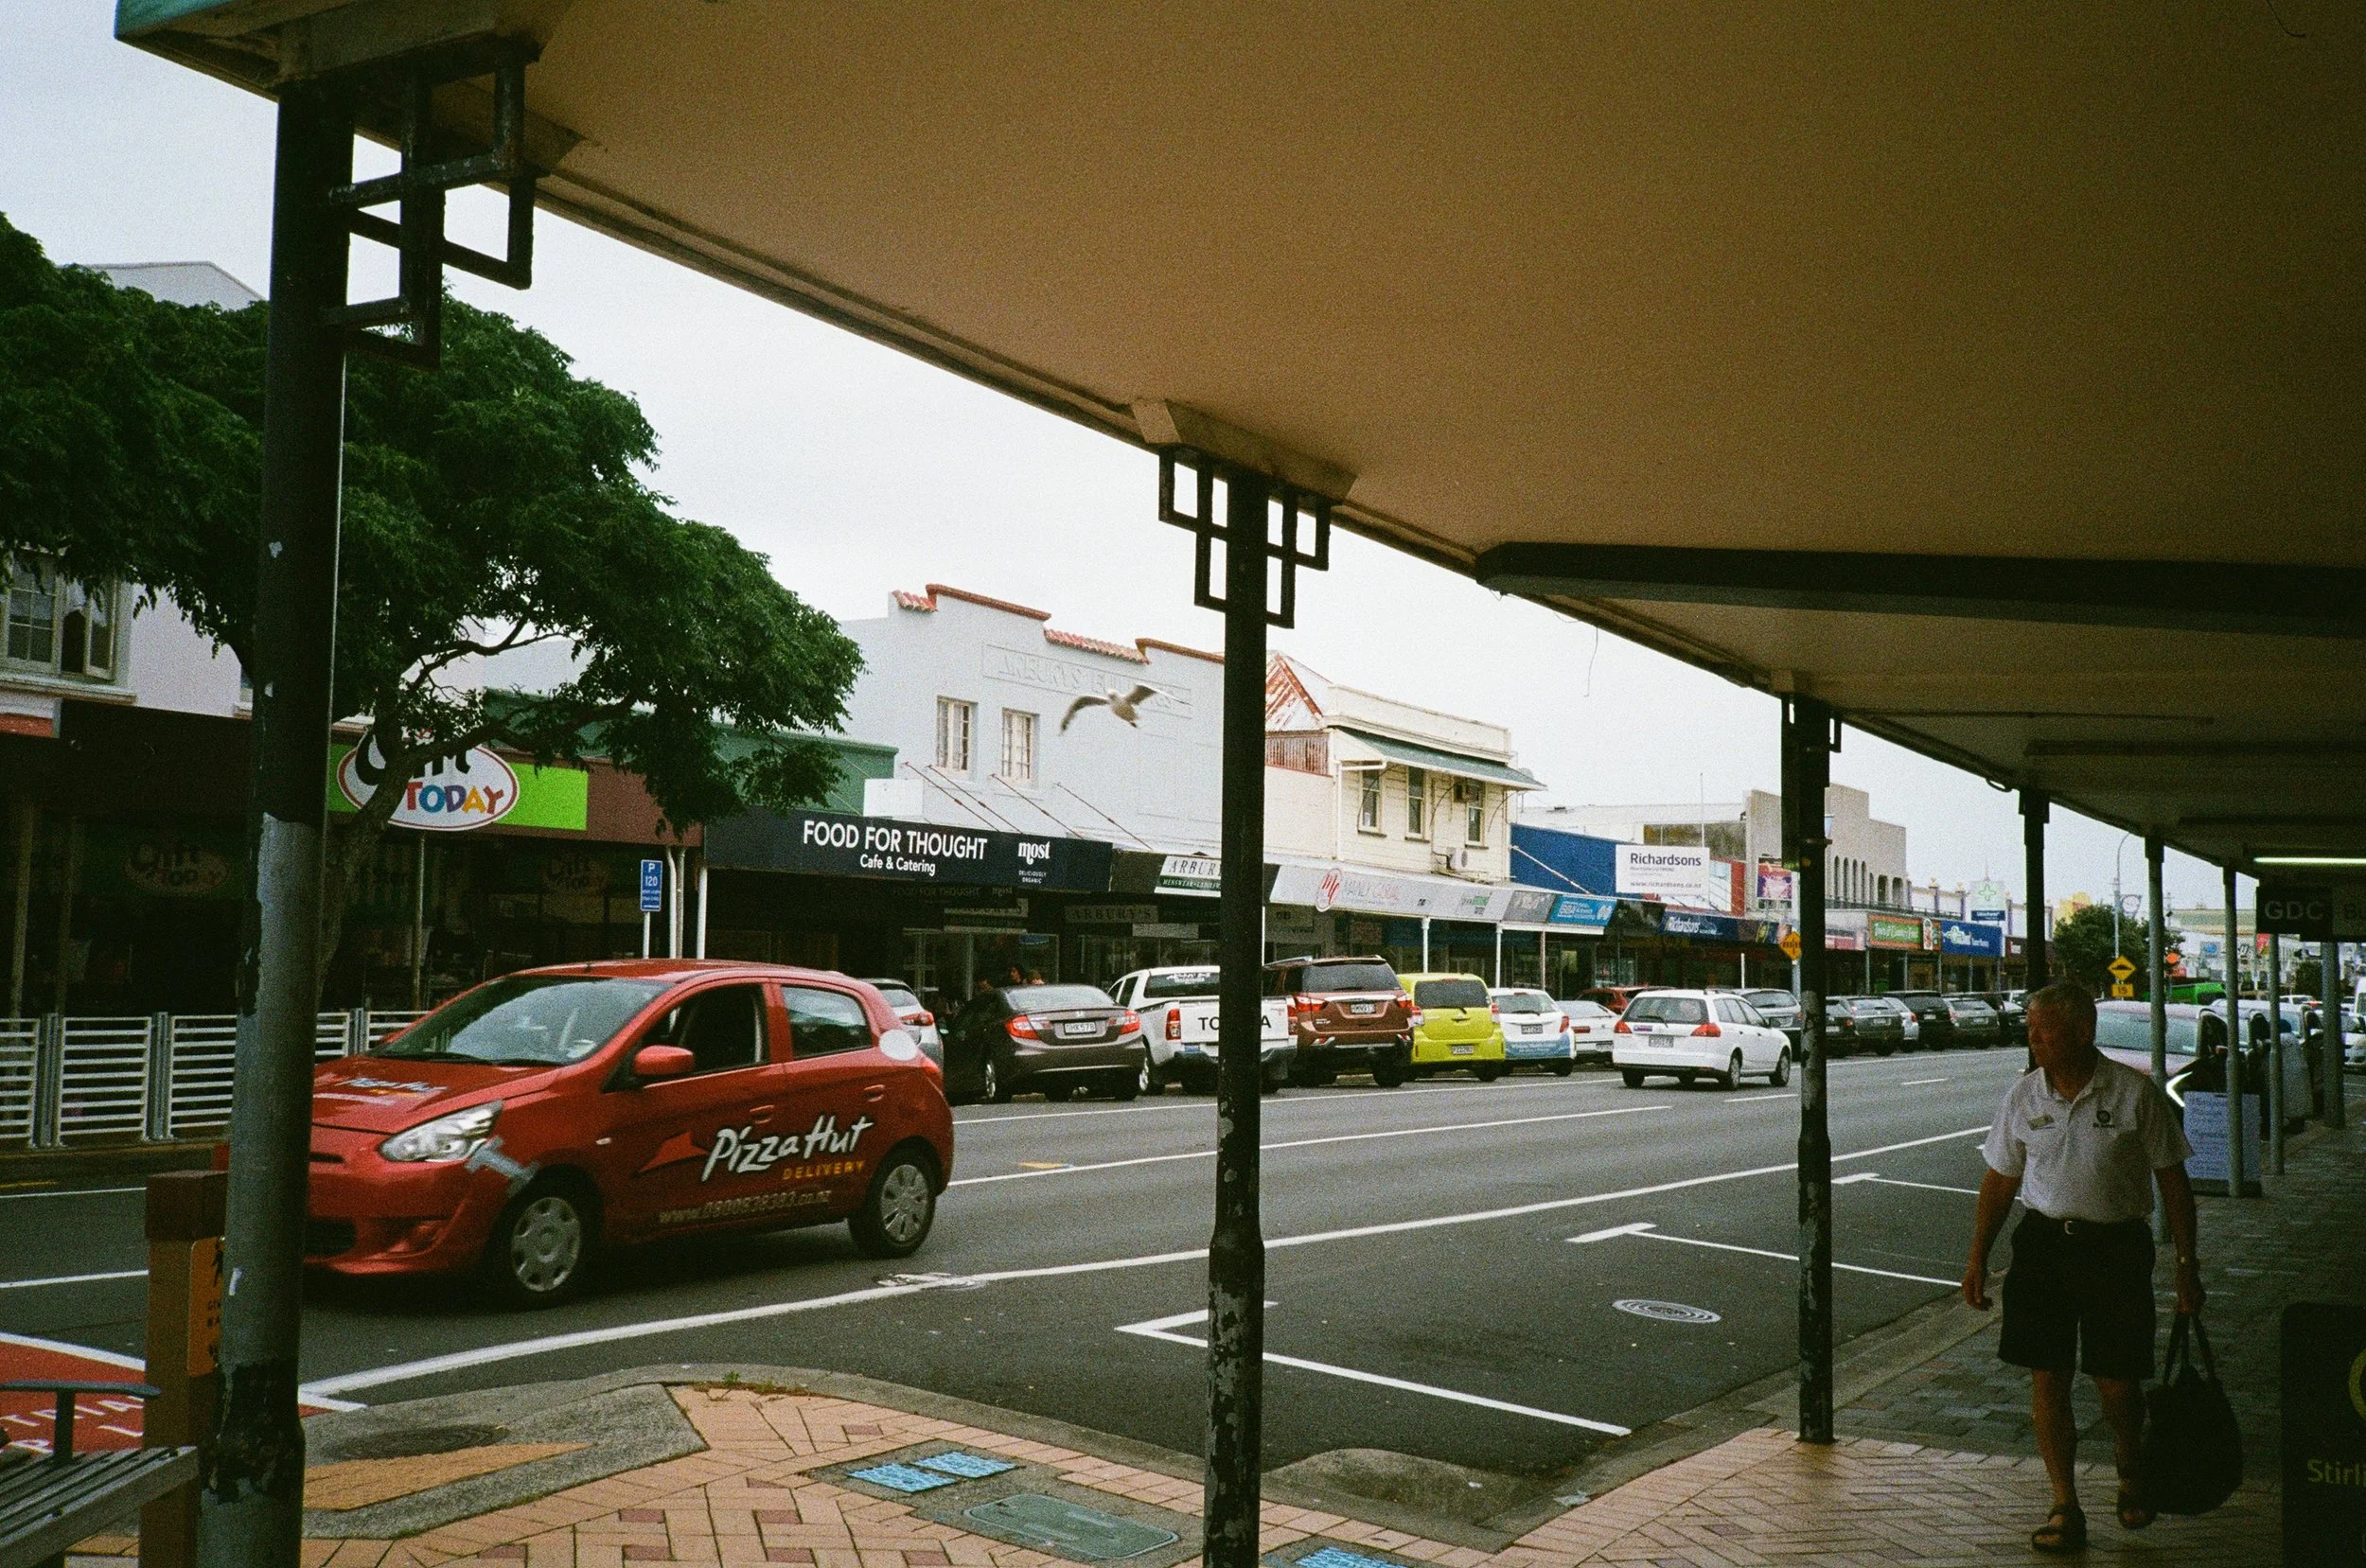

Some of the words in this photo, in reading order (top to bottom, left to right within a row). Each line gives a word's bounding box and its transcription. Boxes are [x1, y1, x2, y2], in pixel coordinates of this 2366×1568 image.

[405, 782, 504, 815] TODAY
[803, 819, 860, 849] FOOD
[865, 826, 902, 853] FOR
[907, 830, 988, 860] THOUGHT
[1018, 841, 1051, 865] most
[1630, 853, 1702, 866] Richardsons
[648, 862, 656, 873] P
[859, 854, 884, 870] Cafe
[886, 856, 894, 870] &
[896, 857, 936, 877] Catering
[1169, 860, 1222, 876] ARBUR
[644, 875, 659, 887] 120
[2264, 900, 2323, 920] GDC
[701, 1125, 800, 1183] Pizza
[803, 1115, 874, 1160] Hut
[783, 1160, 866, 1181] DELIVERY
